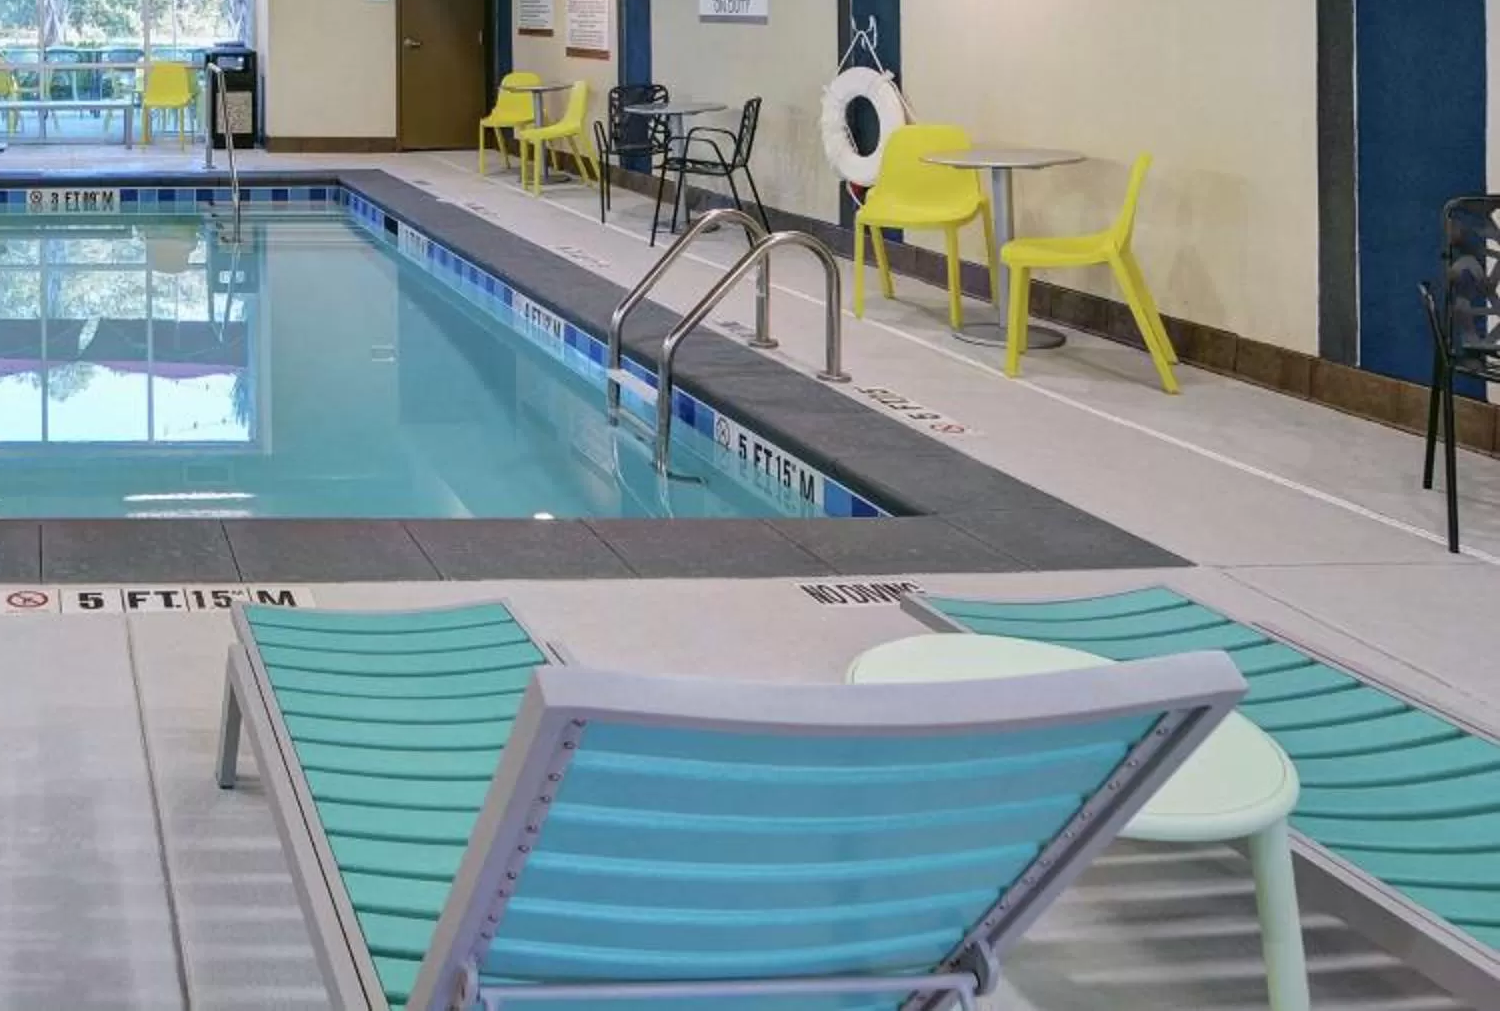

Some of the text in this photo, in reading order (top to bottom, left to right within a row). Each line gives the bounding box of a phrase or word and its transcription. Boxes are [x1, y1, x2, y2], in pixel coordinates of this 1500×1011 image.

[739, 432, 747, 460] 5
[800, 469, 815, 504] M
[78, 591, 104, 610] 5
[256, 590, 298, 608] M
[800, 583, 848, 605] NO
